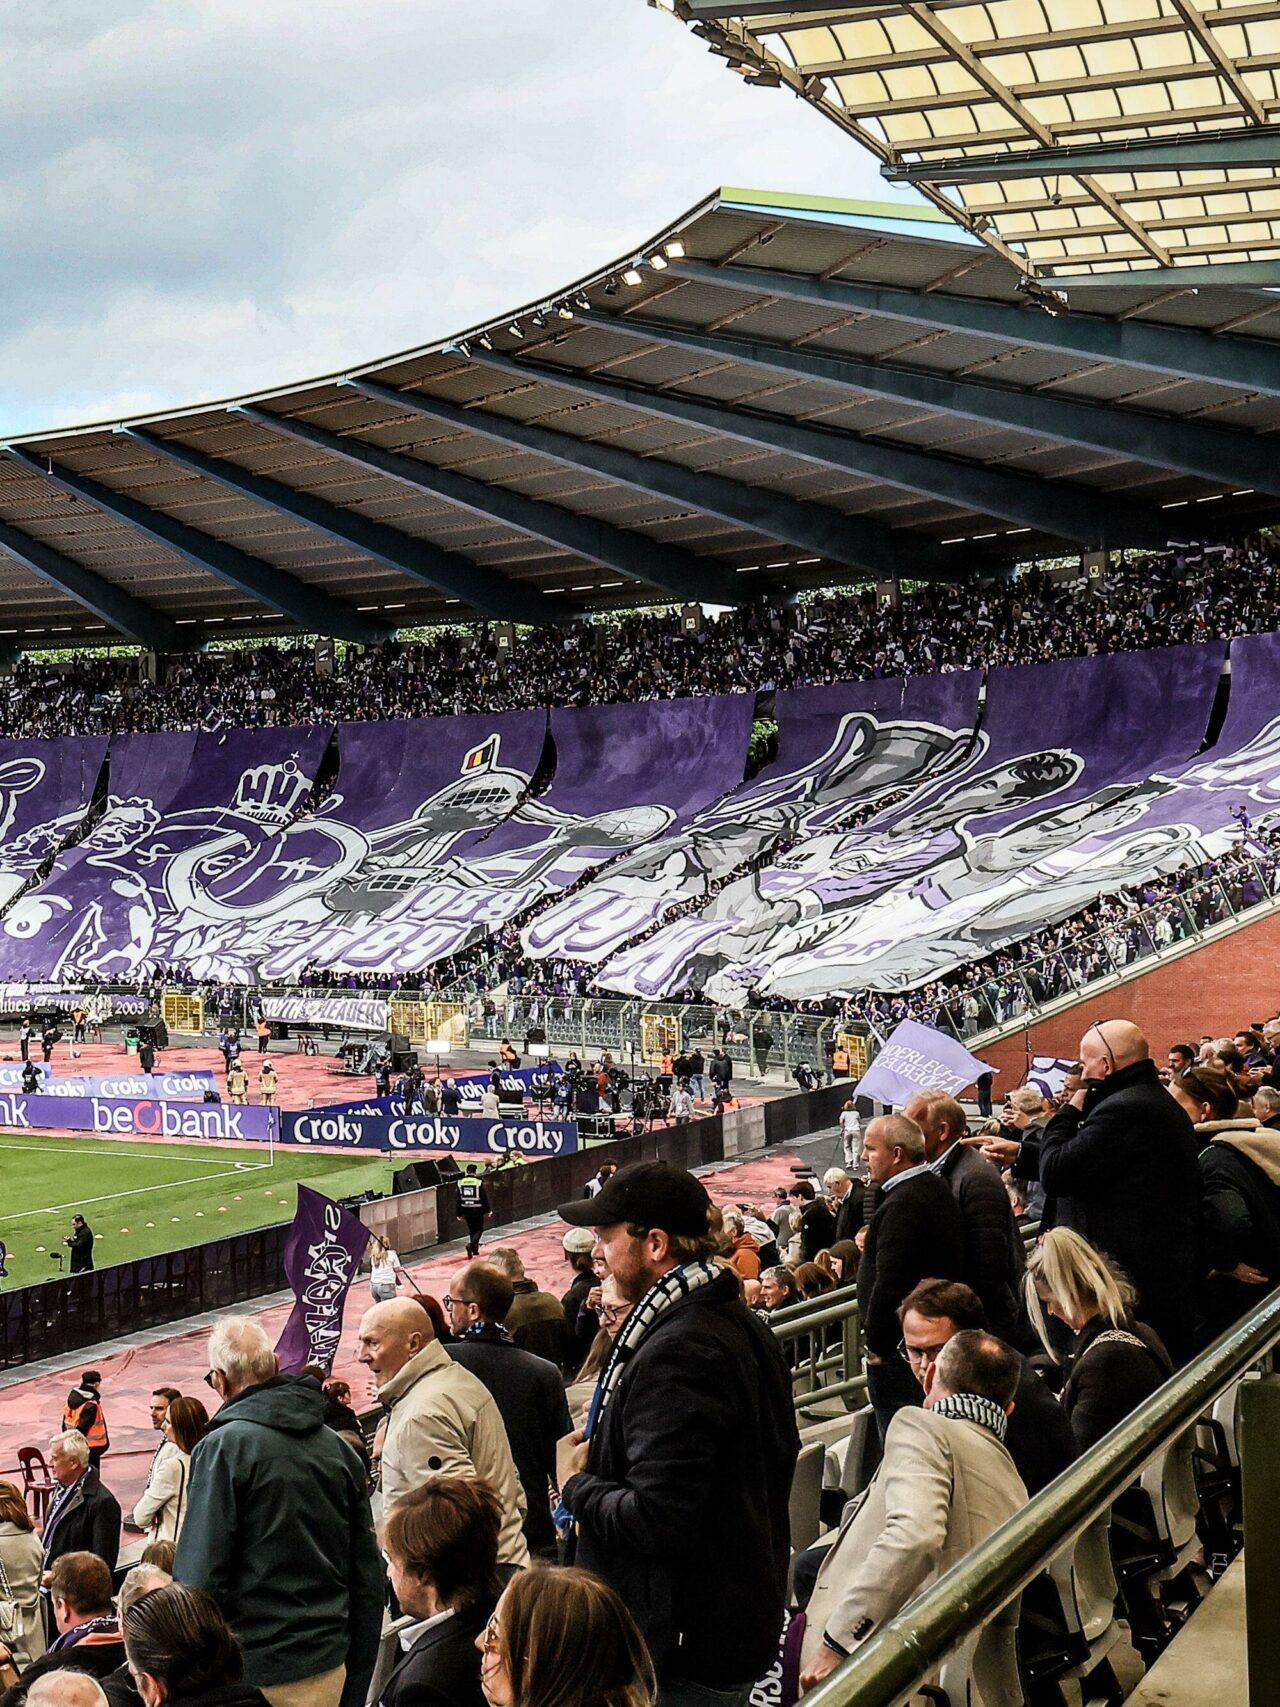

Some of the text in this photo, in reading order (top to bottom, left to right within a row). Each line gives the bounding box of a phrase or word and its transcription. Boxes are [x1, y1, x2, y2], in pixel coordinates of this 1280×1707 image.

[116, 1000, 145, 1016] 2003
[100, 1078, 148, 1098] Croky
[163, 1074, 209, 1095] Croky
[294, 1115, 563, 1153] Croky Croky Croky
